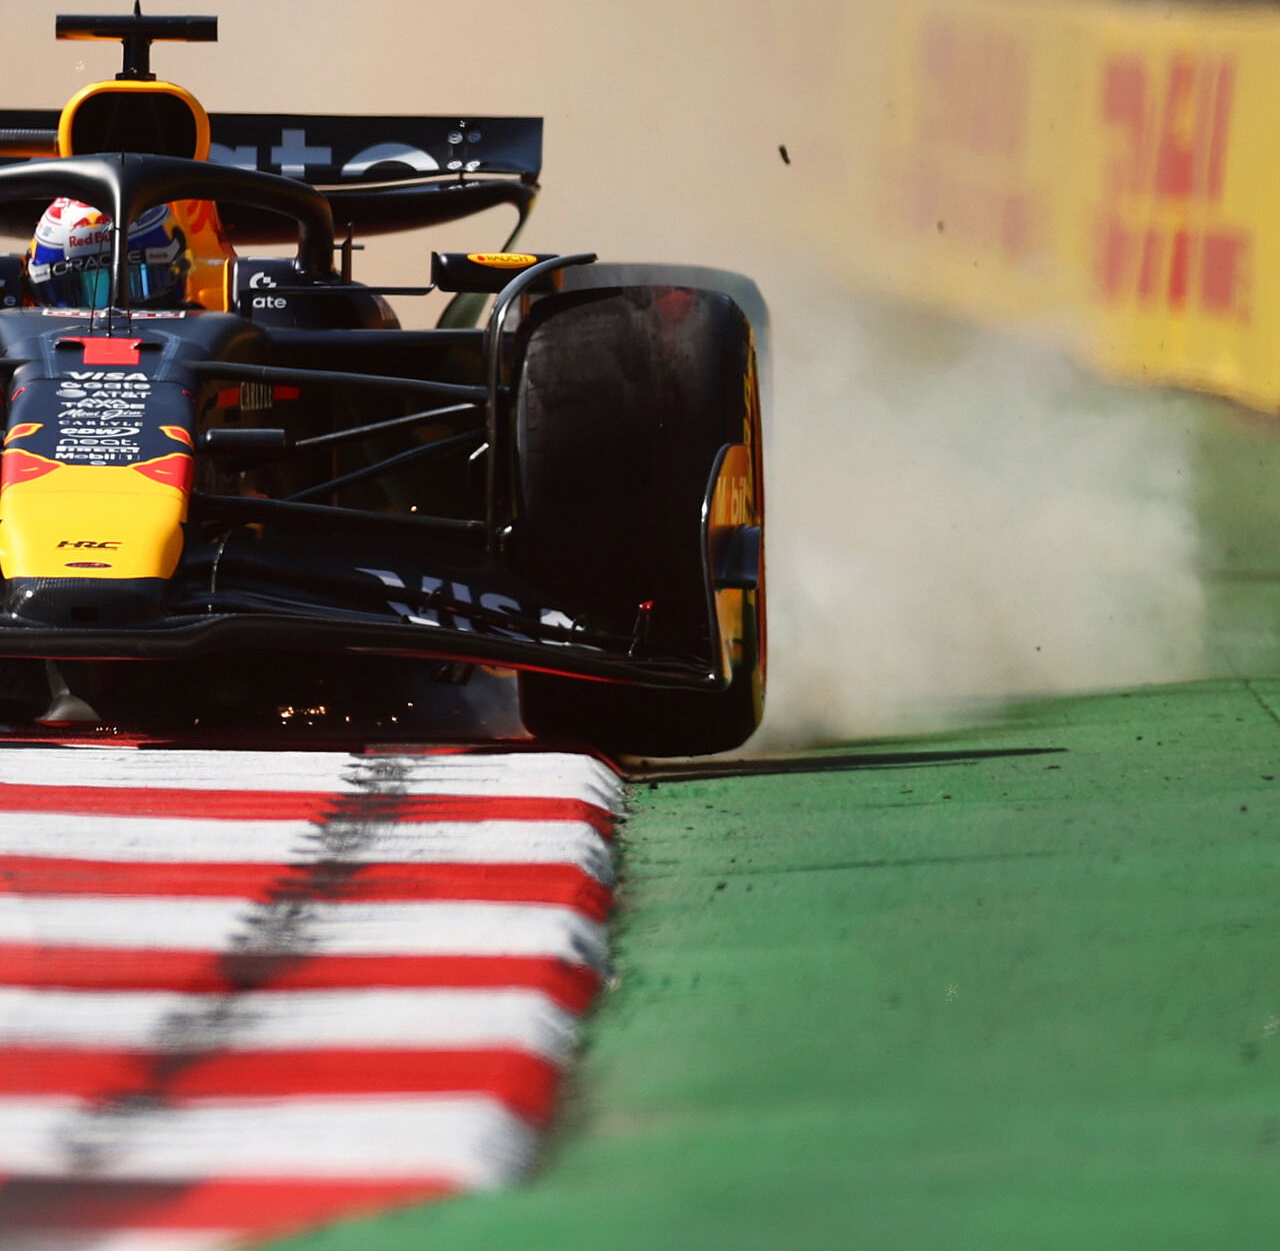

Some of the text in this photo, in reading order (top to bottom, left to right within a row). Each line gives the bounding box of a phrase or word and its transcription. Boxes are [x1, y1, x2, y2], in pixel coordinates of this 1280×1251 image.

[68, 234, 93, 248] Red
[63, 372, 148, 381] VISA
[92, 391, 152, 399] AT&T
[57, 540, 123, 550] HRC
